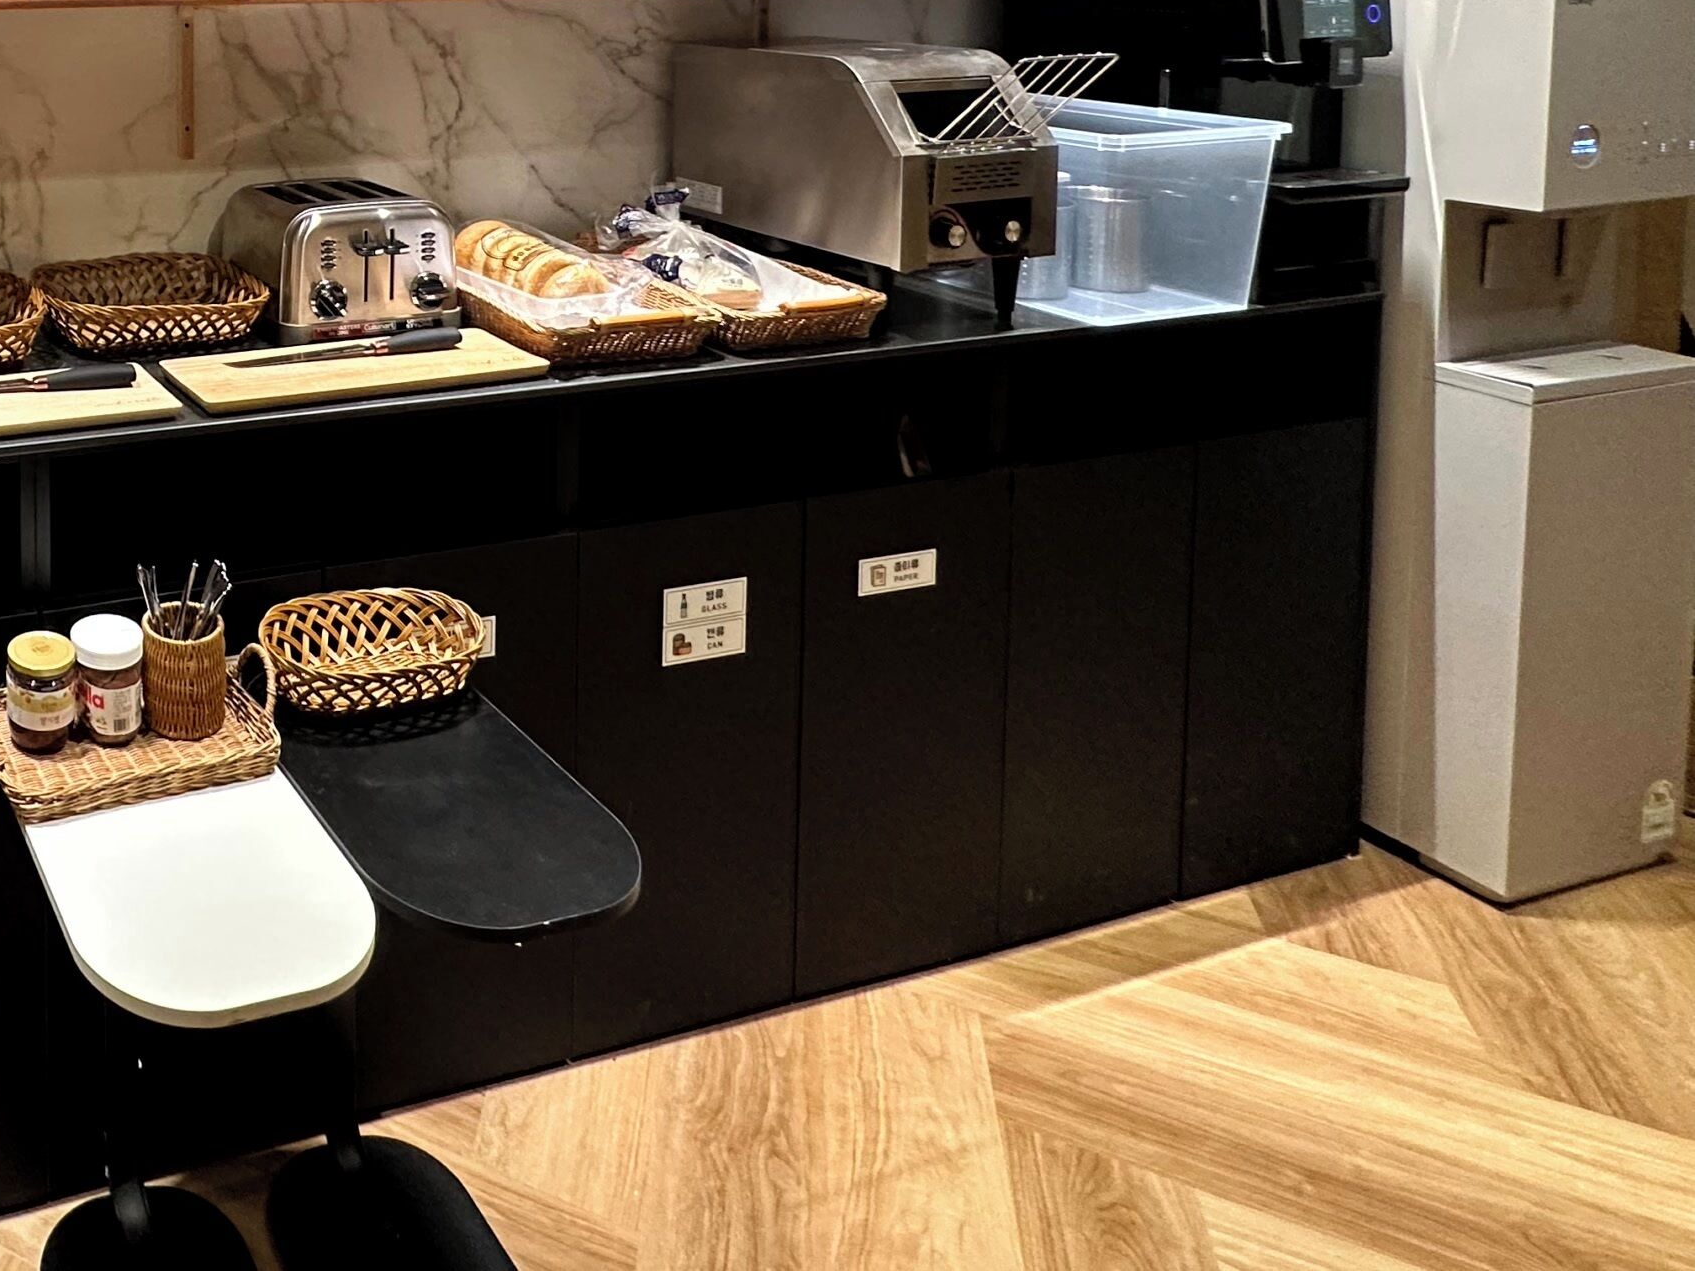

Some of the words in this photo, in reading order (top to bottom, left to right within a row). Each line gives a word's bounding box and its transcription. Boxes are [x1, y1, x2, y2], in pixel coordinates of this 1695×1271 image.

[893, 573, 918, 582] PAPER
[701, 602, 727, 613] GLASS
[707, 641, 723, 650] CAN
